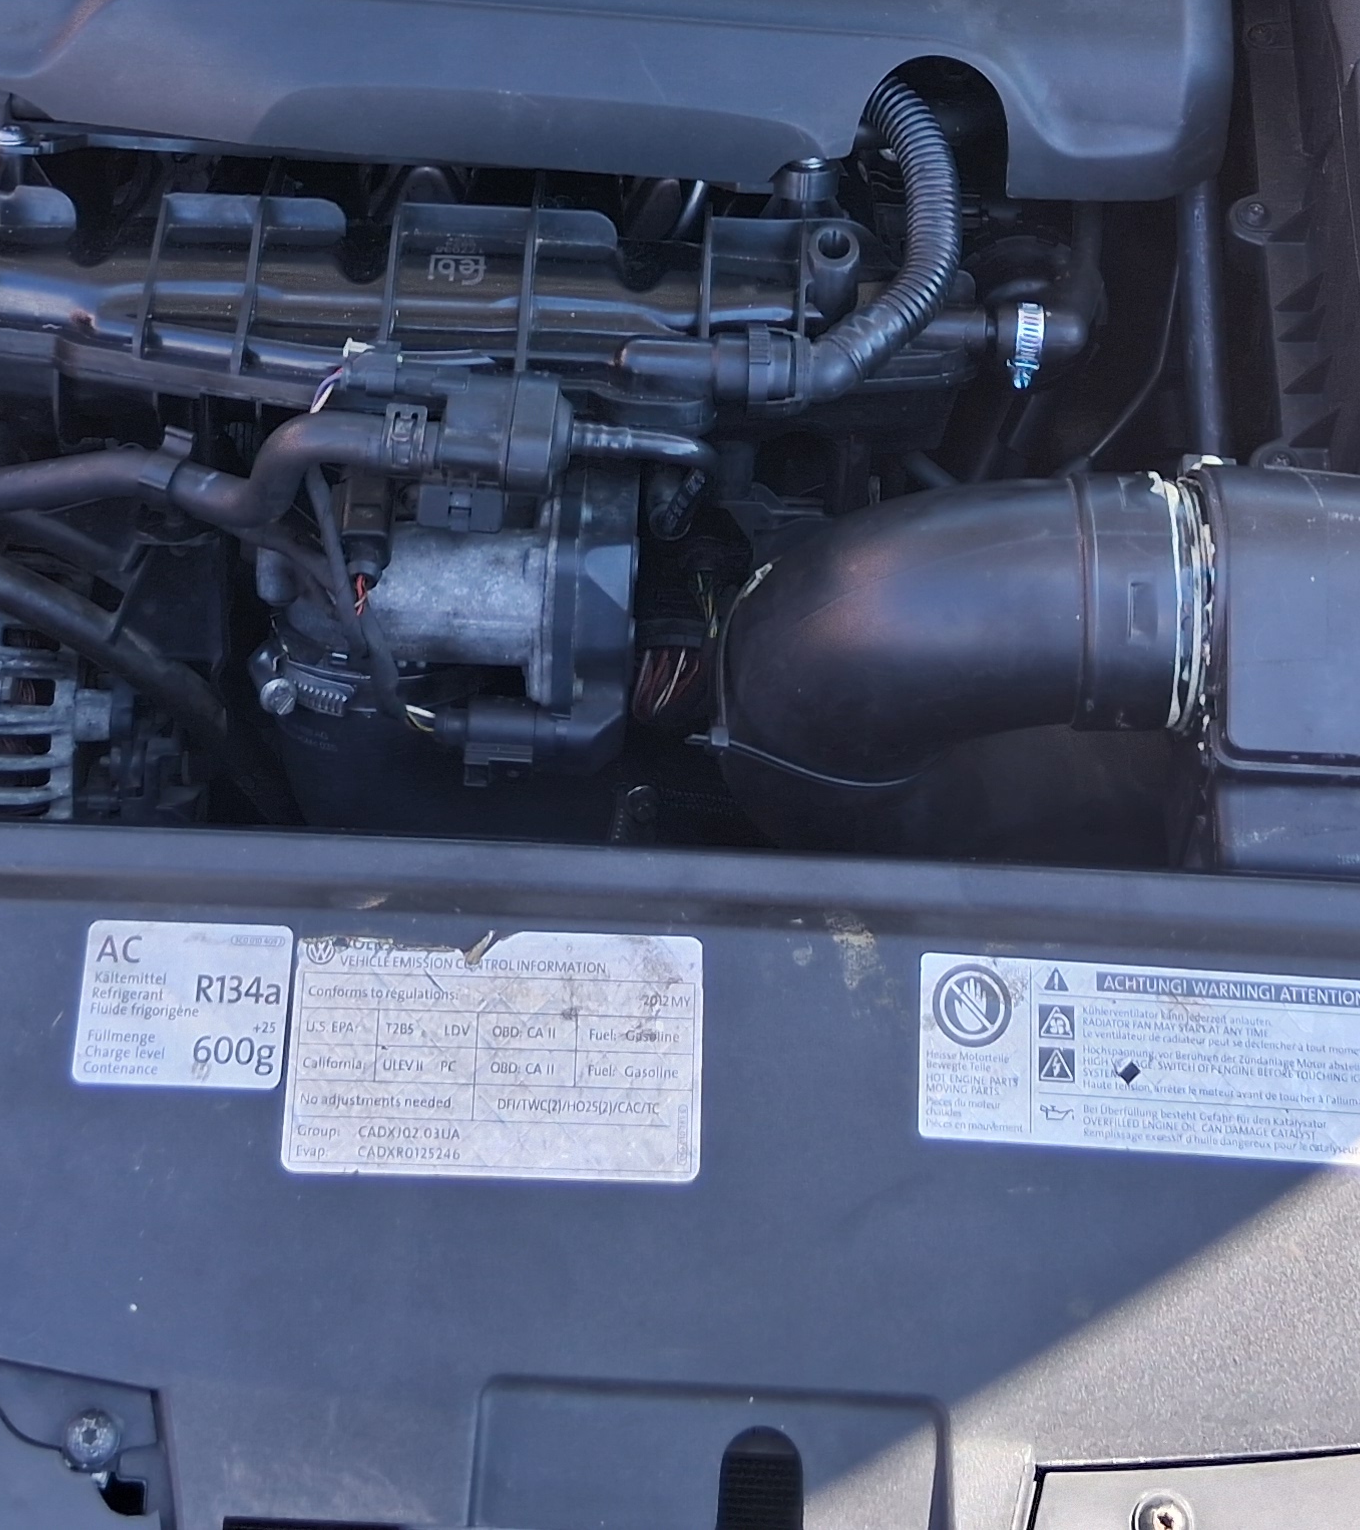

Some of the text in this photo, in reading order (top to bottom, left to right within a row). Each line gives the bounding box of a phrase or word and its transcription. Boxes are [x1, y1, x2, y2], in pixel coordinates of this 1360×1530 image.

[427, 255, 487, 286] febi
[96, 934, 143, 963] AC
[340, 955, 390, 968] VEHICLE
[392, 957, 453, 970] EMISSION
[517, 959, 607, 974] INFORMATION
[91, 987, 164, 1003] Refrigerant
[195, 974, 283, 1005] R134a
[309, 985, 459, 1003] Conforms to regulations:
[1103, 975, 1188, 994] ACHTUNG!
[1192, 980, 1276, 1000] WARNING!
[671, 996, 691, 1008] MY
[90, 1002, 200, 1021] Fluide frigorigène
[253, 1021, 277, 1034] +25
[386, 1022, 471, 1036] T2B5 LDV
[527, 1027, 544, 1039] CA
[589, 1028, 680, 1043] Fuel: Gasoline
[1082, 1017, 1130, 1029] RADIATOR
[1132, 1020, 1151, 1031] FAN
[1154, 1022, 1176, 1033] MAY
[1223, 1026, 1242, 1038] ANY
[1082, 1028, 1093, 1038] Le
[1095, 1030, 1146, 1042] ventilateur
[1149, 1032, 1161, 1043] de
[1163, 1034, 1206, 1045] radiateur
[1209, 1037, 1230, 1050] peut
[1232, 1040, 1243, 1048] se
[1307, 1043, 1327, 1053] tout
[85, 1045, 165, 1061] Charge level
[192, 1035, 277, 1076] 600g
[926, 1049, 1010, 1064] Heisse Motorteile
[82, 1061, 158, 1075] Contenance
[383, 1058, 414, 1071] ULEV
[440, 1060, 457, 1072] PC
[525, 1063, 543, 1075] CA
[971, 1062, 991, 1073] Teile
[1082, 1057, 1108, 1067] HIGH
[1157, 1061, 1196, 1073] SWITCH
[1296, 1070, 1348, 1084] TOUCHING
[1158, 1053, 1173, 1062] vor
[1221, 1055, 1237, 1066] der
[1297, 1059, 1327, 1071] Motor
[588, 1064, 679, 1079] Fuel: Gasoline
[926, 1073, 1019, 1087] HOT ENGINE PARTS
[926, 1083, 1000, 1096] MOVING PARTS
[1082, 1078, 1112, 1090] Haute
[1199, 1088, 1234, 1098] moteur
[1237, 1090, 1264, 1100] avant
[1265, 1090, 1277, 1101] de
[1279, 1092, 1317, 1104] toucher
[300, 1092, 319, 1105] No
[322, 1093, 401, 1110] adjustments
[954, 1097, 1001, 1110] du moteur
[1083, 1104, 1328, 1130] Bei besteht Gefahr den Katalysator
[954, 1121, 1023, 1133] en mouvement
[1083, 1116, 1141, 1129] OVERFILLED
[1143, 1120, 1178, 1132] ENGINE
[1201, 1123, 1222, 1135] CAN
[1224, 1126, 1268, 1139] DAMAGE
[1270, 1129, 1316, 1141] CATALYST
[1083, 1127, 1143, 1143] Remplissage
[1220, 1137, 1271, 1151] dangereux
[1273, 1140, 1297, 1153] pour
